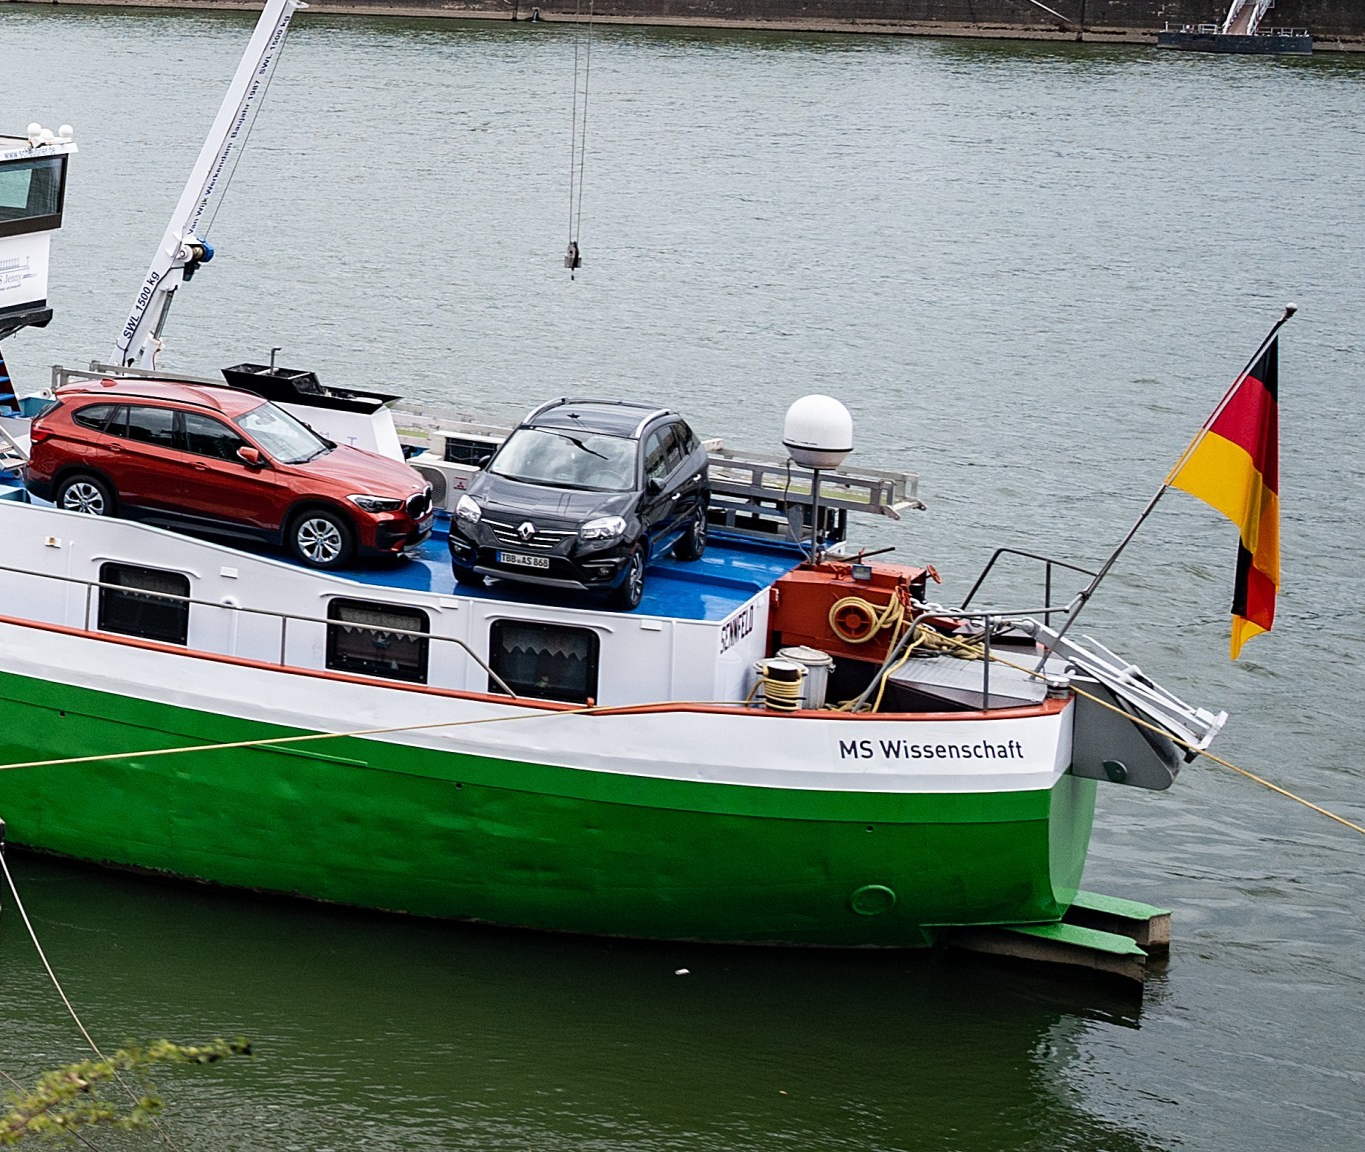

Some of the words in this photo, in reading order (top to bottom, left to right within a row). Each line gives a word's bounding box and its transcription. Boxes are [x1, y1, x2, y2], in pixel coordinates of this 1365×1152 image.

[259, 54, 273, 75] SWL
[270, 29, 283, 50] 1500
[280, 15, 291, 27] kg
[123, 316, 140, 339] SWL
[135, 286, 151, 311] 1500
[146, 271, 160, 286] kg
[502, 553, 516, 563] TBB
[522, 556, 532, 566] AS
[533, 558, 548, 568] 868
[839, 740, 874, 759] MS
[879, 740, 1024, 759] Wissenschaft
